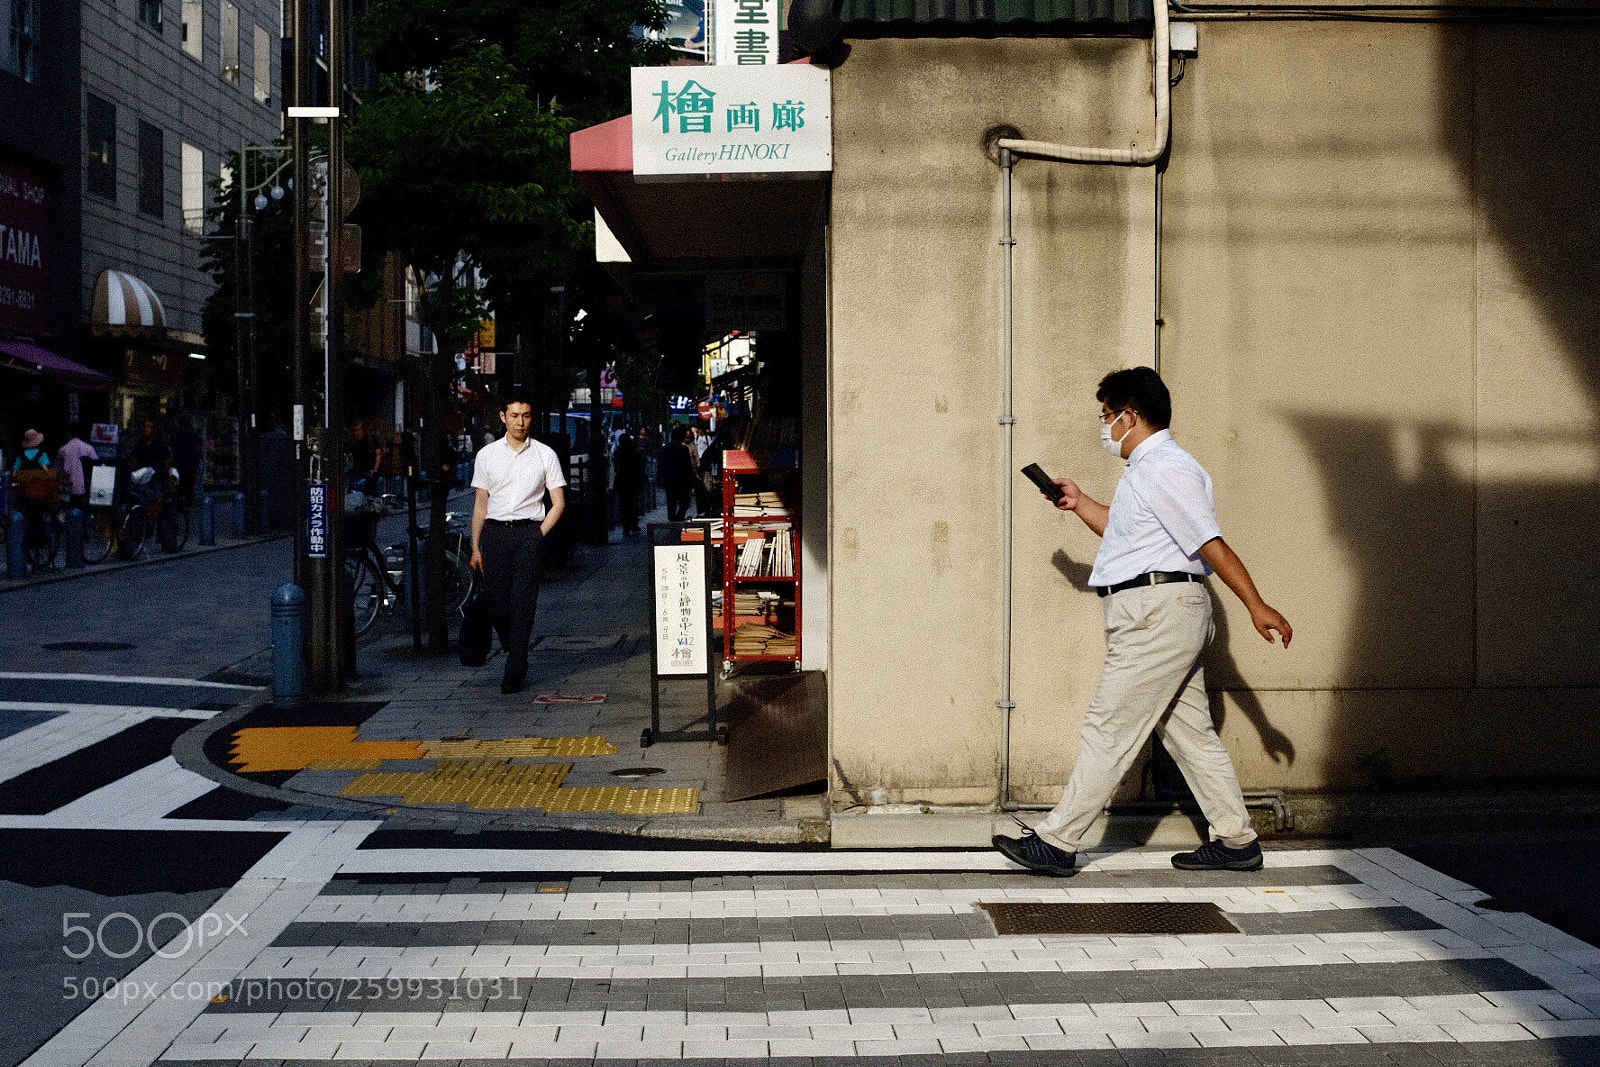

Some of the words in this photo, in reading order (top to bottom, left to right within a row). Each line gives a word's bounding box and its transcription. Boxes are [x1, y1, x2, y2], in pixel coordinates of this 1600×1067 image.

[652, 79, 806, 134] 檜画廊
[310, 487, 324, 552] 防犯カメラ作動中
